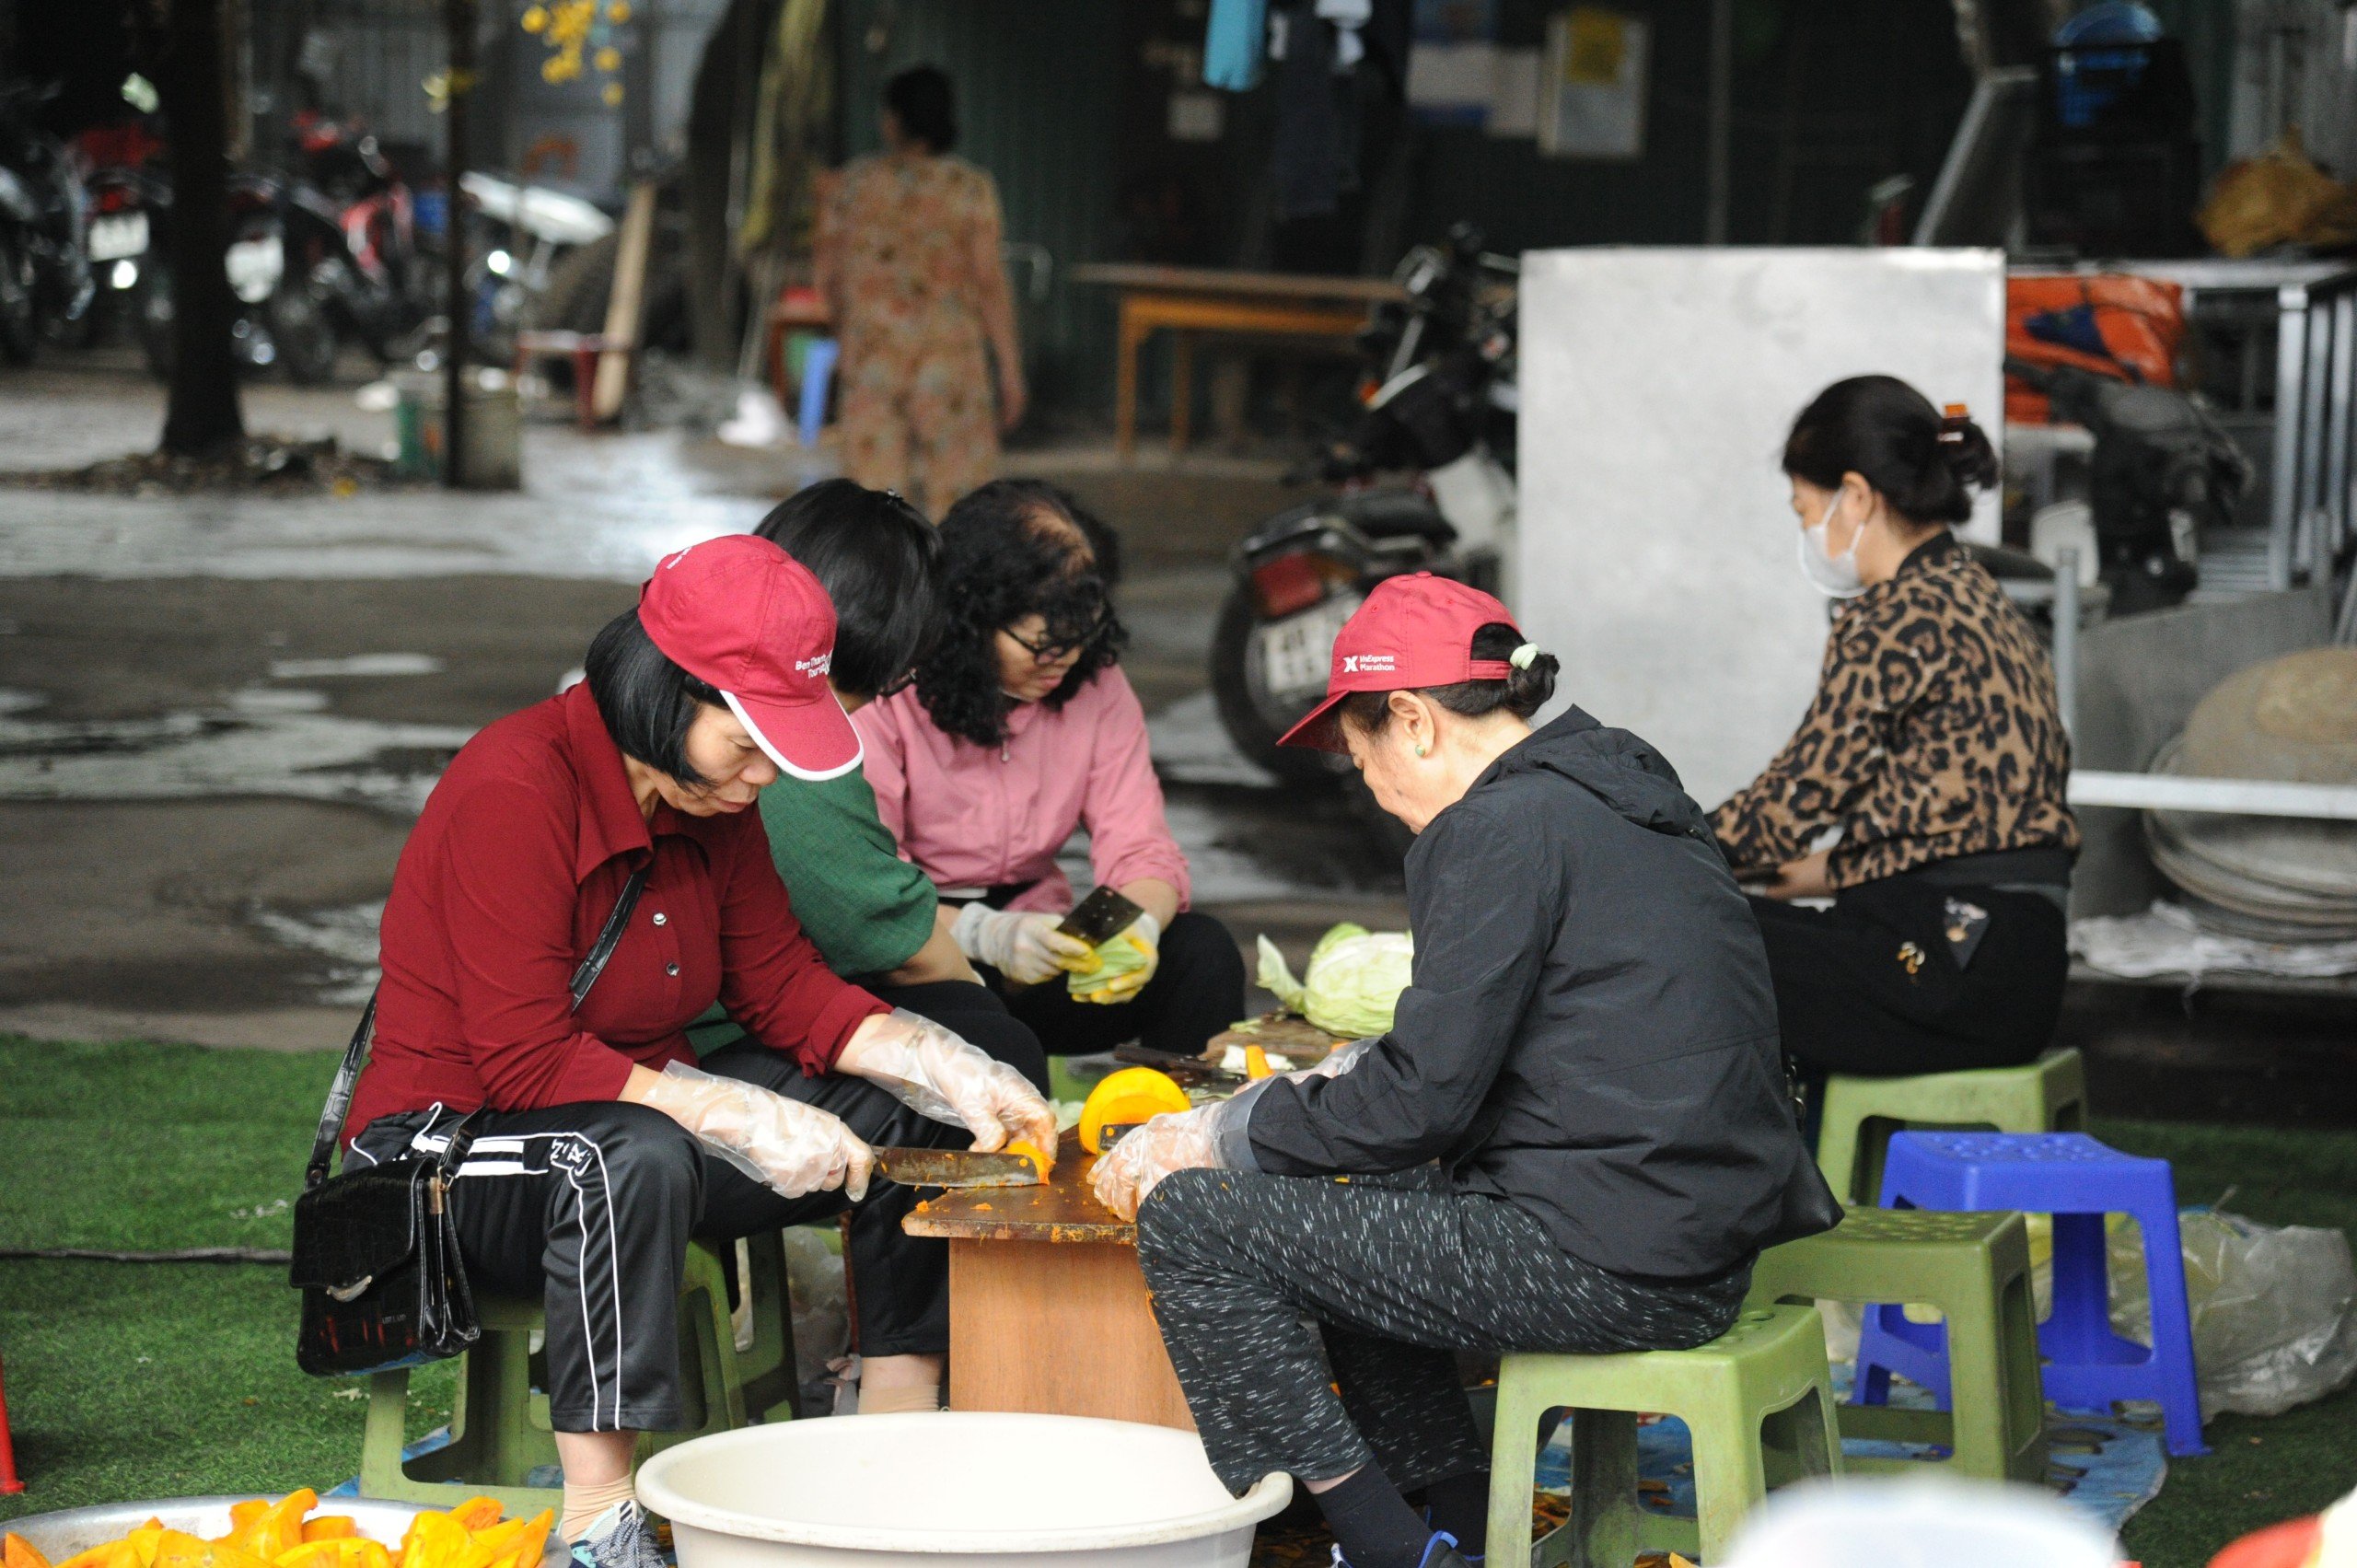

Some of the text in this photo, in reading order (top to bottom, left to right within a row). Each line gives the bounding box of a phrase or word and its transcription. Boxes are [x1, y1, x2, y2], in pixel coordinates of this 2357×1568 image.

[1360, 655, 1395, 664] VnExpress
[795, 660, 810, 671] Ben
[1360, 663, 1396, 672] Marathon
